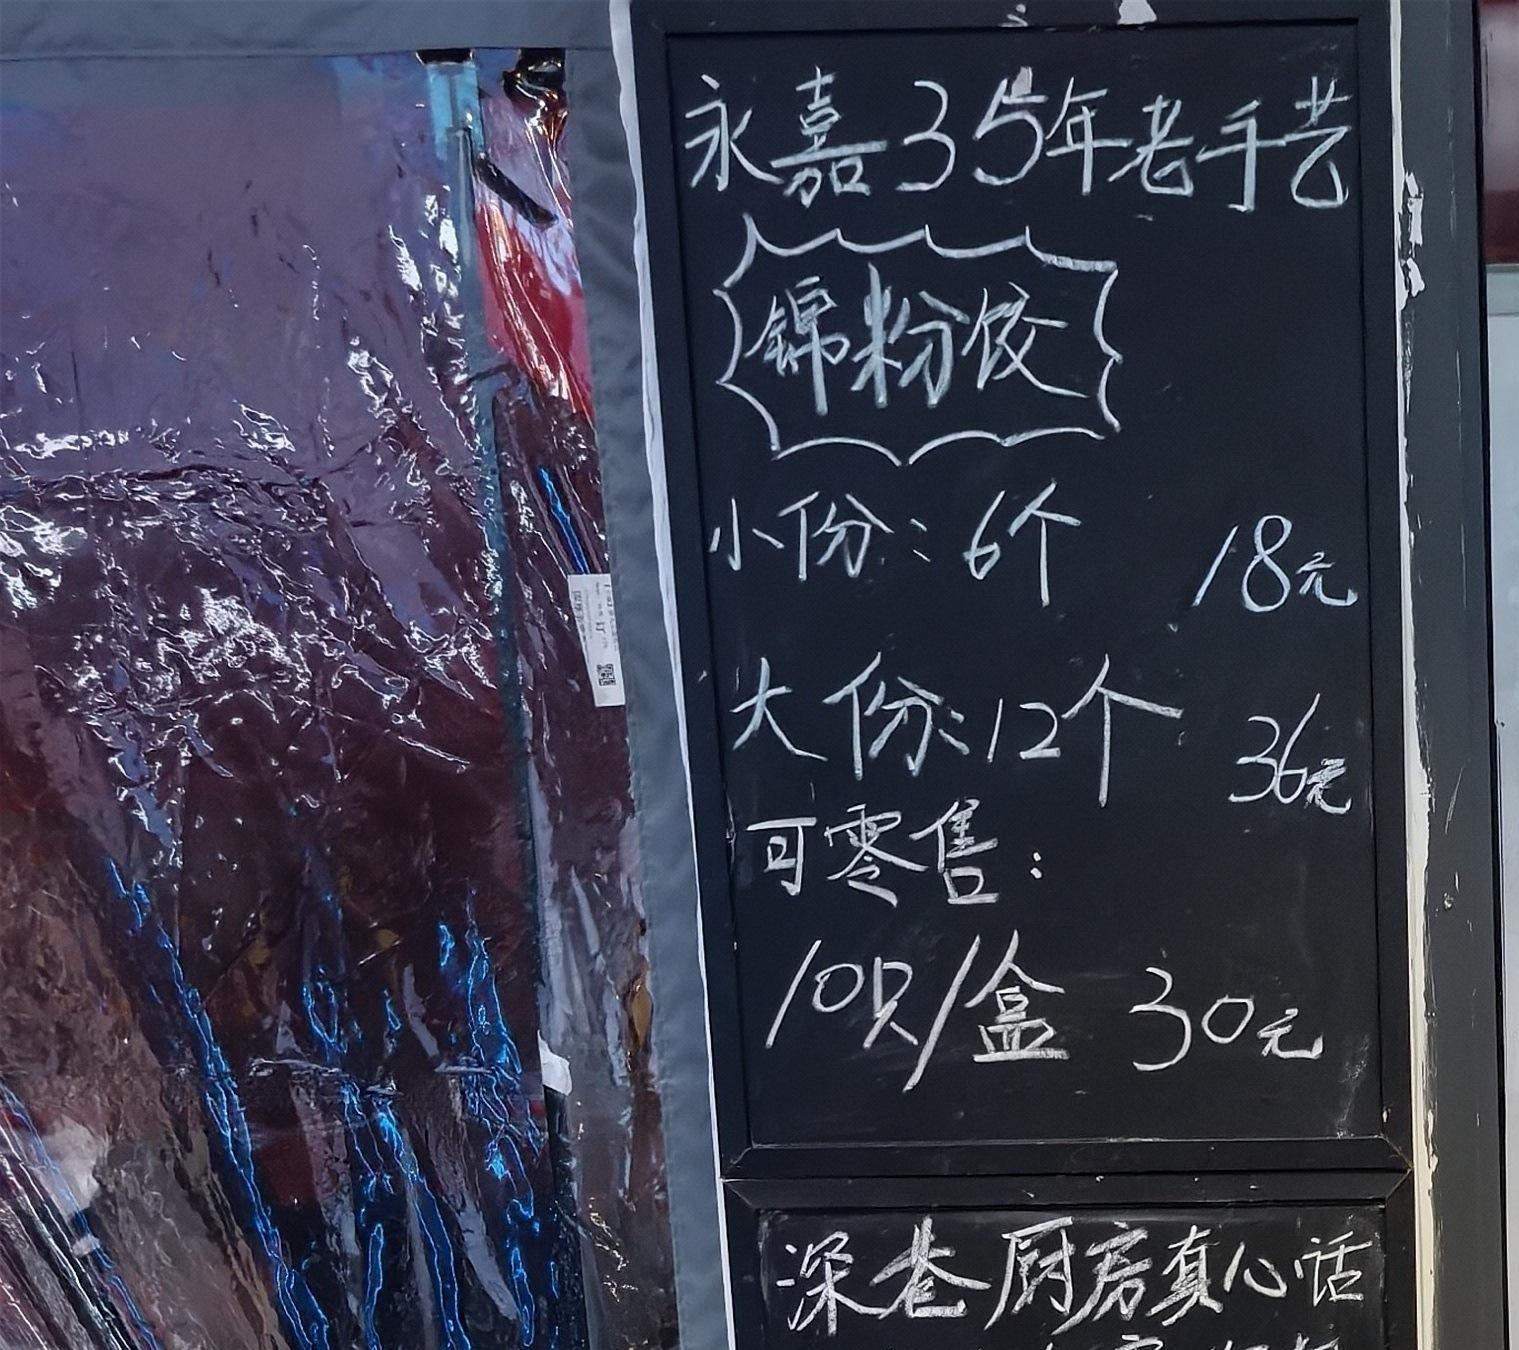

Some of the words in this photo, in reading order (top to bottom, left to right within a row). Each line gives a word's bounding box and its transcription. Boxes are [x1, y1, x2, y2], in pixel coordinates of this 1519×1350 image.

[684, 66, 1353, 212] 永嘉35年老手艺
[1192, 515, 1358, 613] 18元
[1230, 693, 1352, 814] 36元
[1129, 967, 1324, 1072] 30元
[777, 1215, 1372, 1335] 深巷厨房真心话
